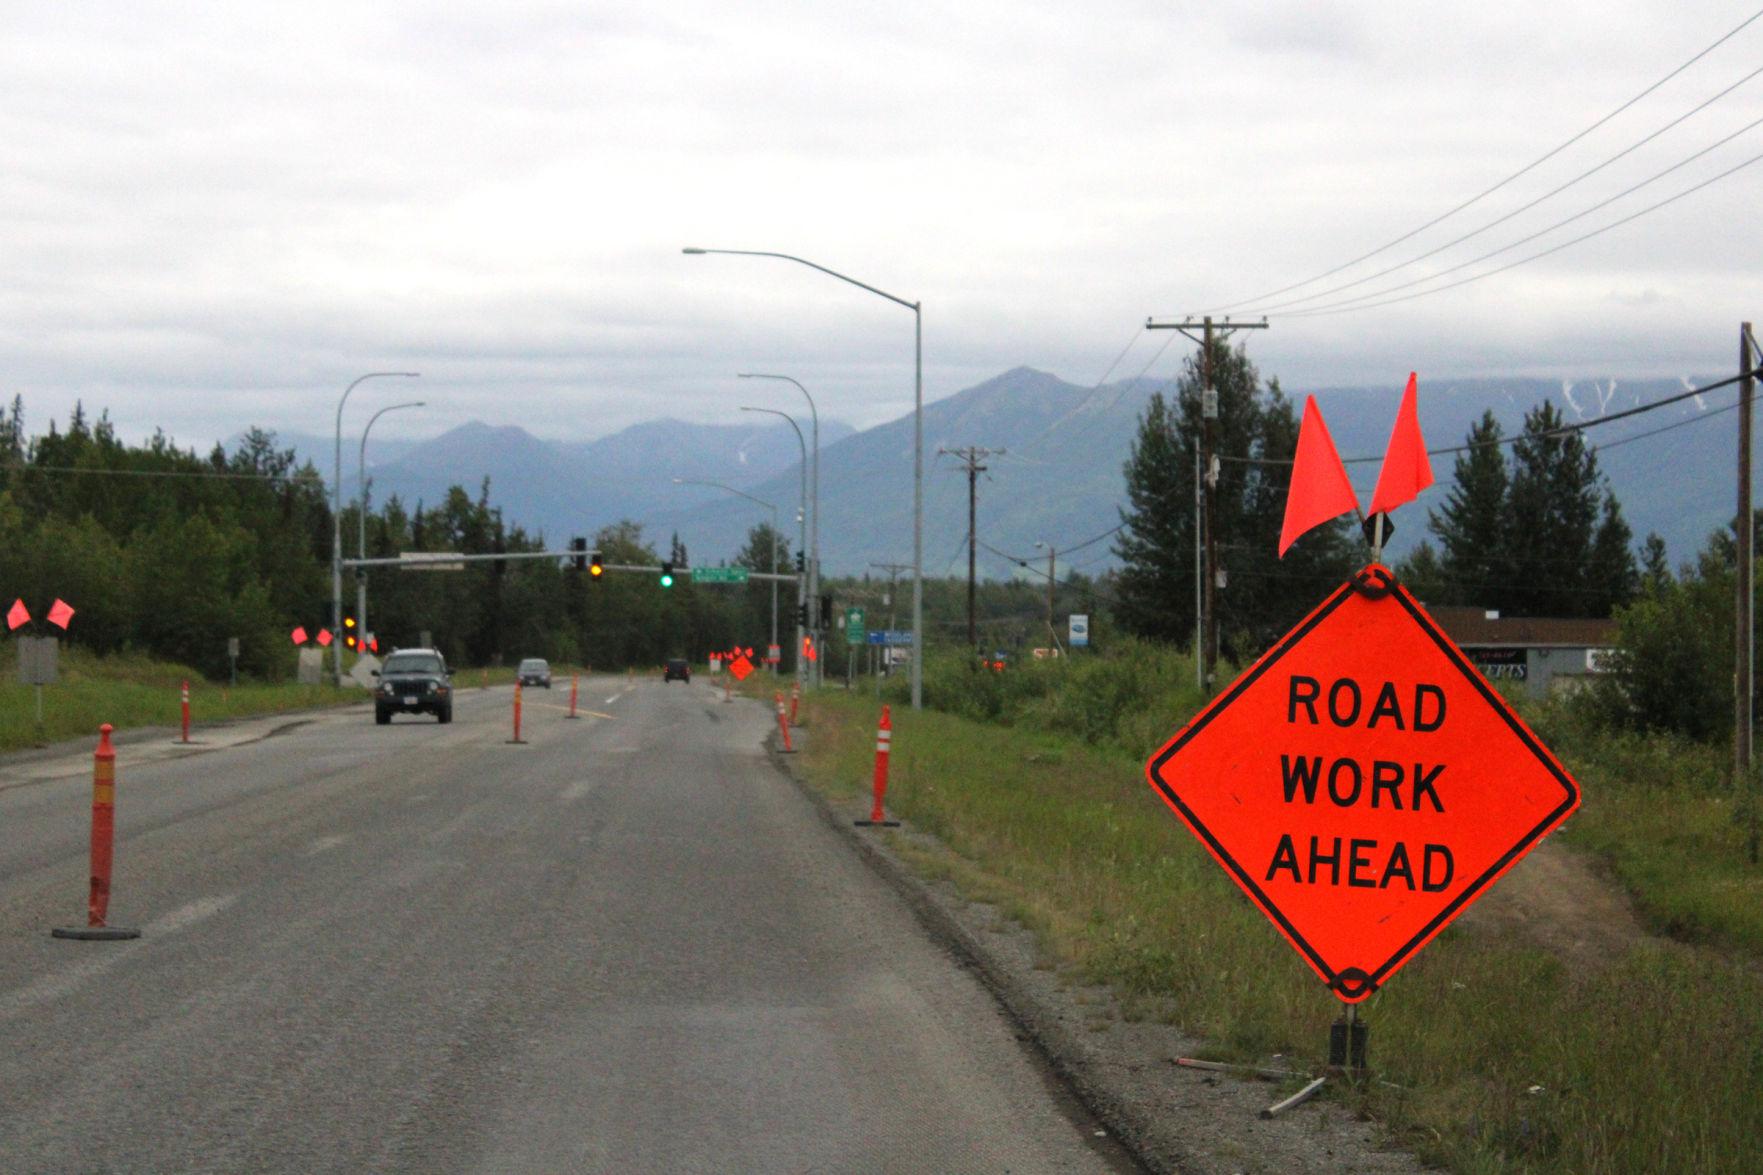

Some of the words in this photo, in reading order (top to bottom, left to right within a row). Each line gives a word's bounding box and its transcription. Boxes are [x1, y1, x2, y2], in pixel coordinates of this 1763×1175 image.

[1287, 675, 1447, 733] ROAD
[1280, 754, 1447, 813] WORK
[1265, 833, 1455, 893] AHEAD
